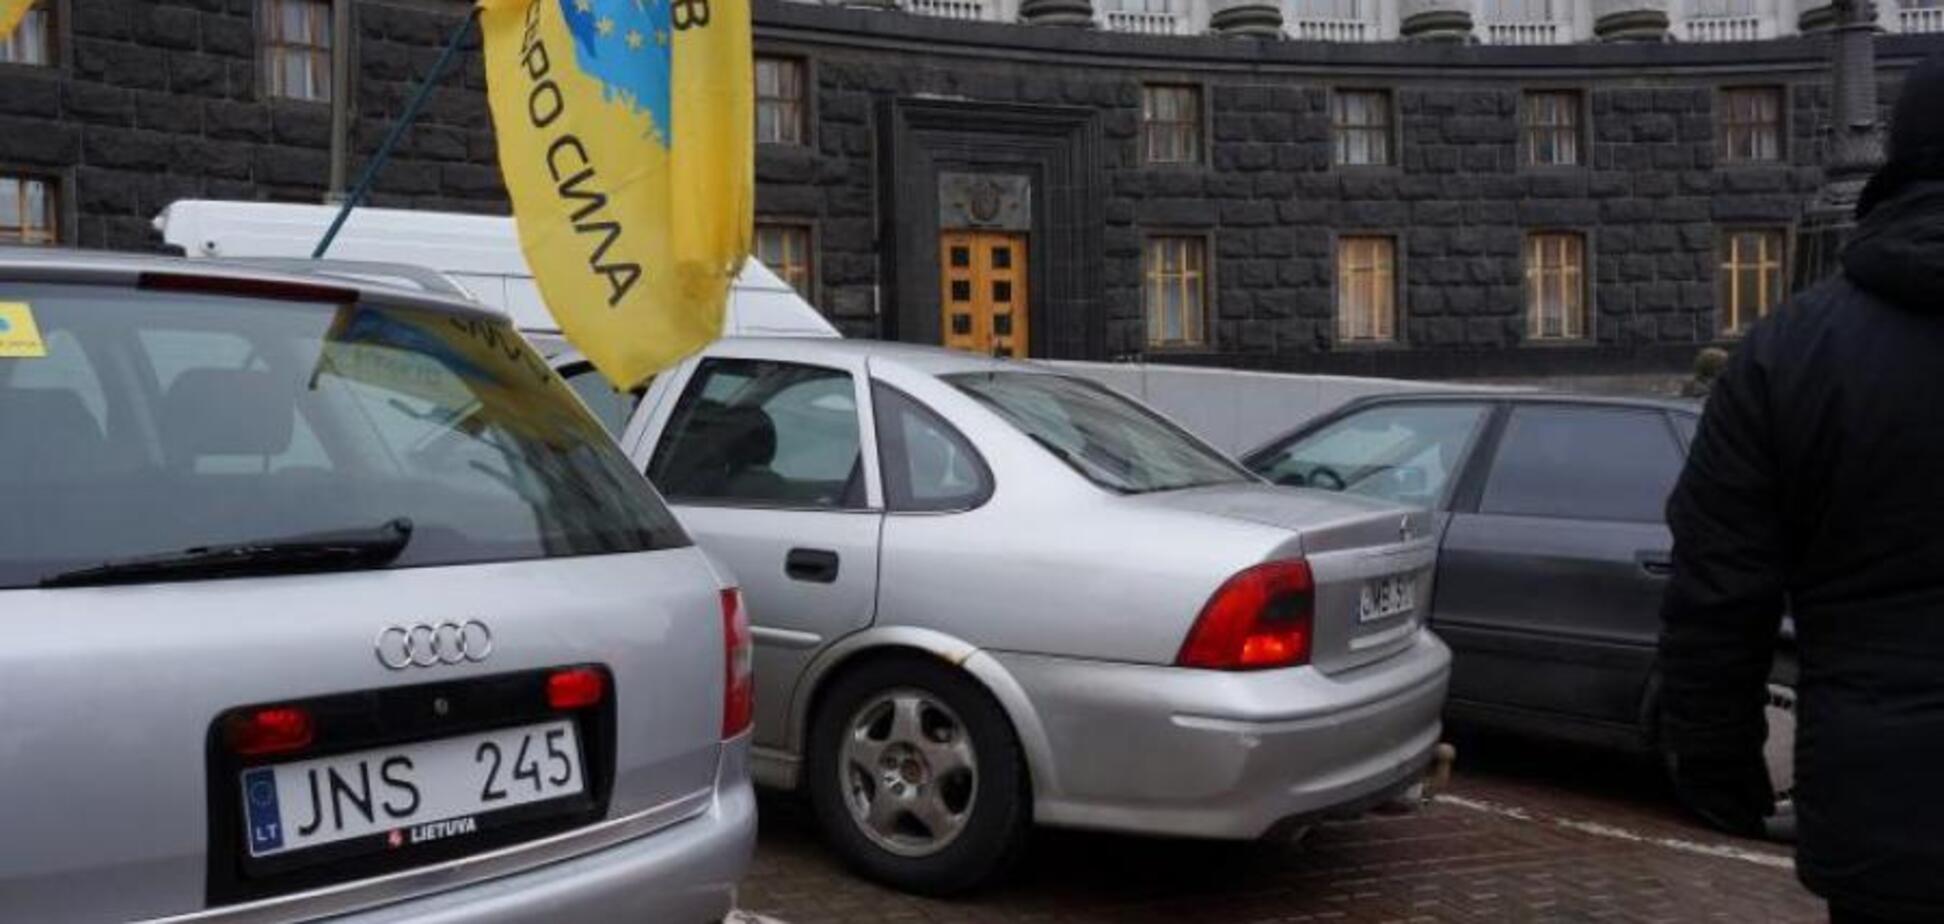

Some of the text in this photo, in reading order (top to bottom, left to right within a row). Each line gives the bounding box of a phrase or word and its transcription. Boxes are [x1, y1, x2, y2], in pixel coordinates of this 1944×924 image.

[546, 134, 642, 307] СИЛА
[298, 729, 573, 836] JNS 245
[256, 823, 278, 841] LT
[411, 817, 477, 843] LIETUVA
